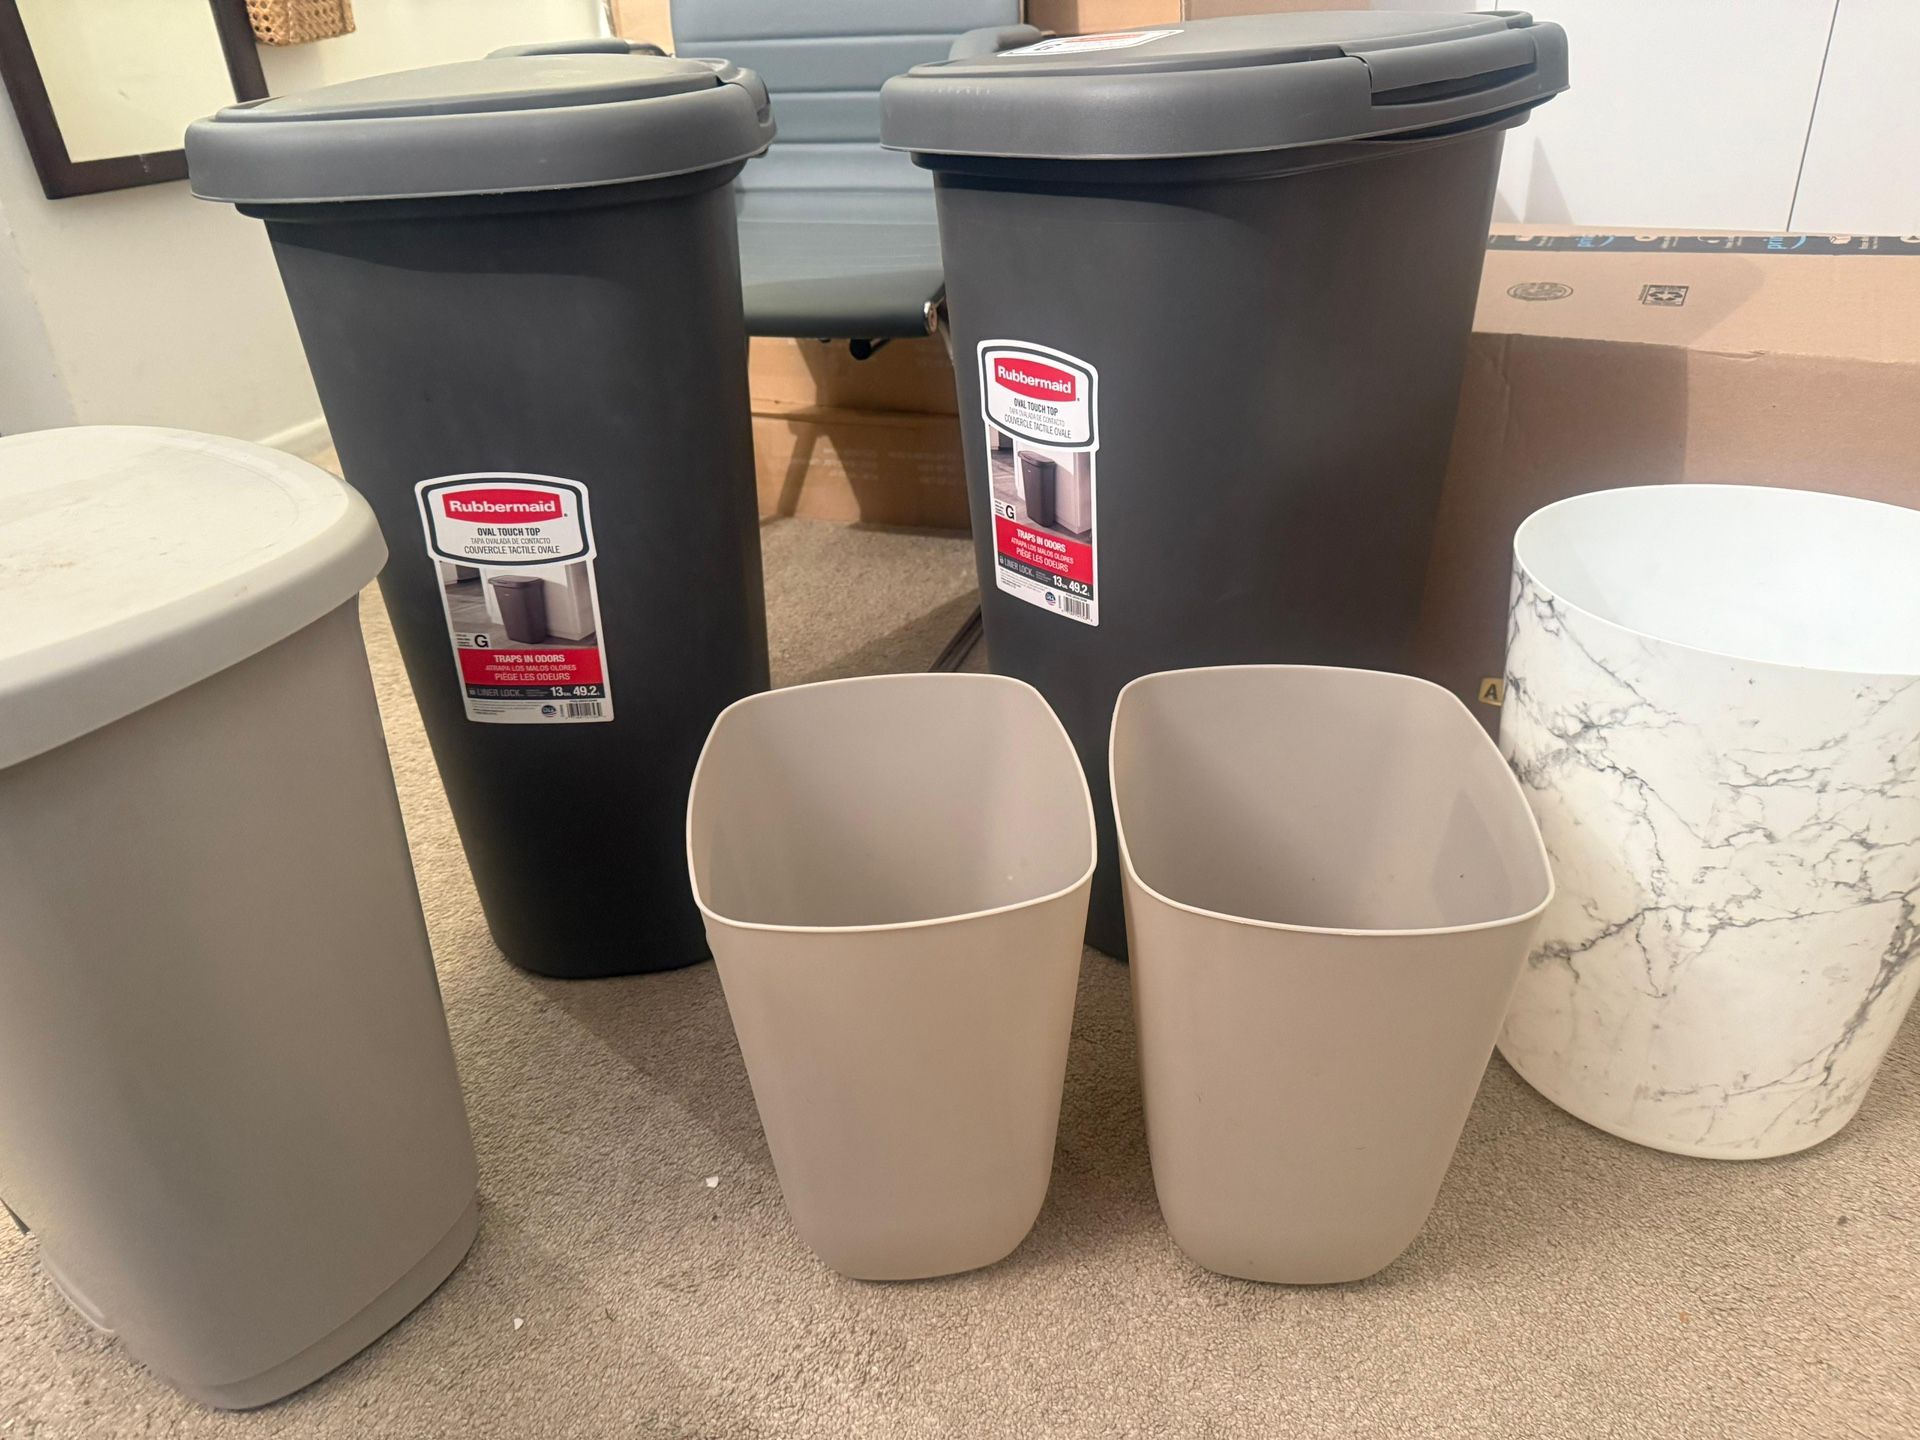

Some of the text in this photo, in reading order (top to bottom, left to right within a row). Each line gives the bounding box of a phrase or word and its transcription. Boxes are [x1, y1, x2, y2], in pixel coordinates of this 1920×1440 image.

[997, 365, 1072, 394] Rubbermaid
[1013, 397, 1058, 416] OVAL TOUCH TOP
[1004, 414, 1072, 439] COUVERCLE TACTILE OVALE
[1042, 415, 1065, 427] CONTACTO
[449, 500, 556, 513] Rubbermaid
[1005, 505, 1015, 520] G
[477, 527, 540, 536] OVAL TOUCH TOP
[1016, 528, 1066, 553] TRAPS IN ODORS
[464, 545, 560, 554] COUVERCLE TACTILE OVALE
[1027, 542, 1036, 552] LOS
[1054, 551, 1074, 564] OLORES
[1016, 547, 1068, 573] PIÈGE LES ODEURS
[1052, 575, 1062, 587] 13
[1069, 581, 1088, 596] 49.2
[474, 634, 488, 648] G
[493, 655, 522, 663] TRAPS
[535, 655, 565, 663] ODORS
[494, 672, 519, 680] PIÈGE
[537, 672, 570, 680] ODEURS
[550, 686, 564, 697] 13
[573, 686, 597, 696] 49.2
